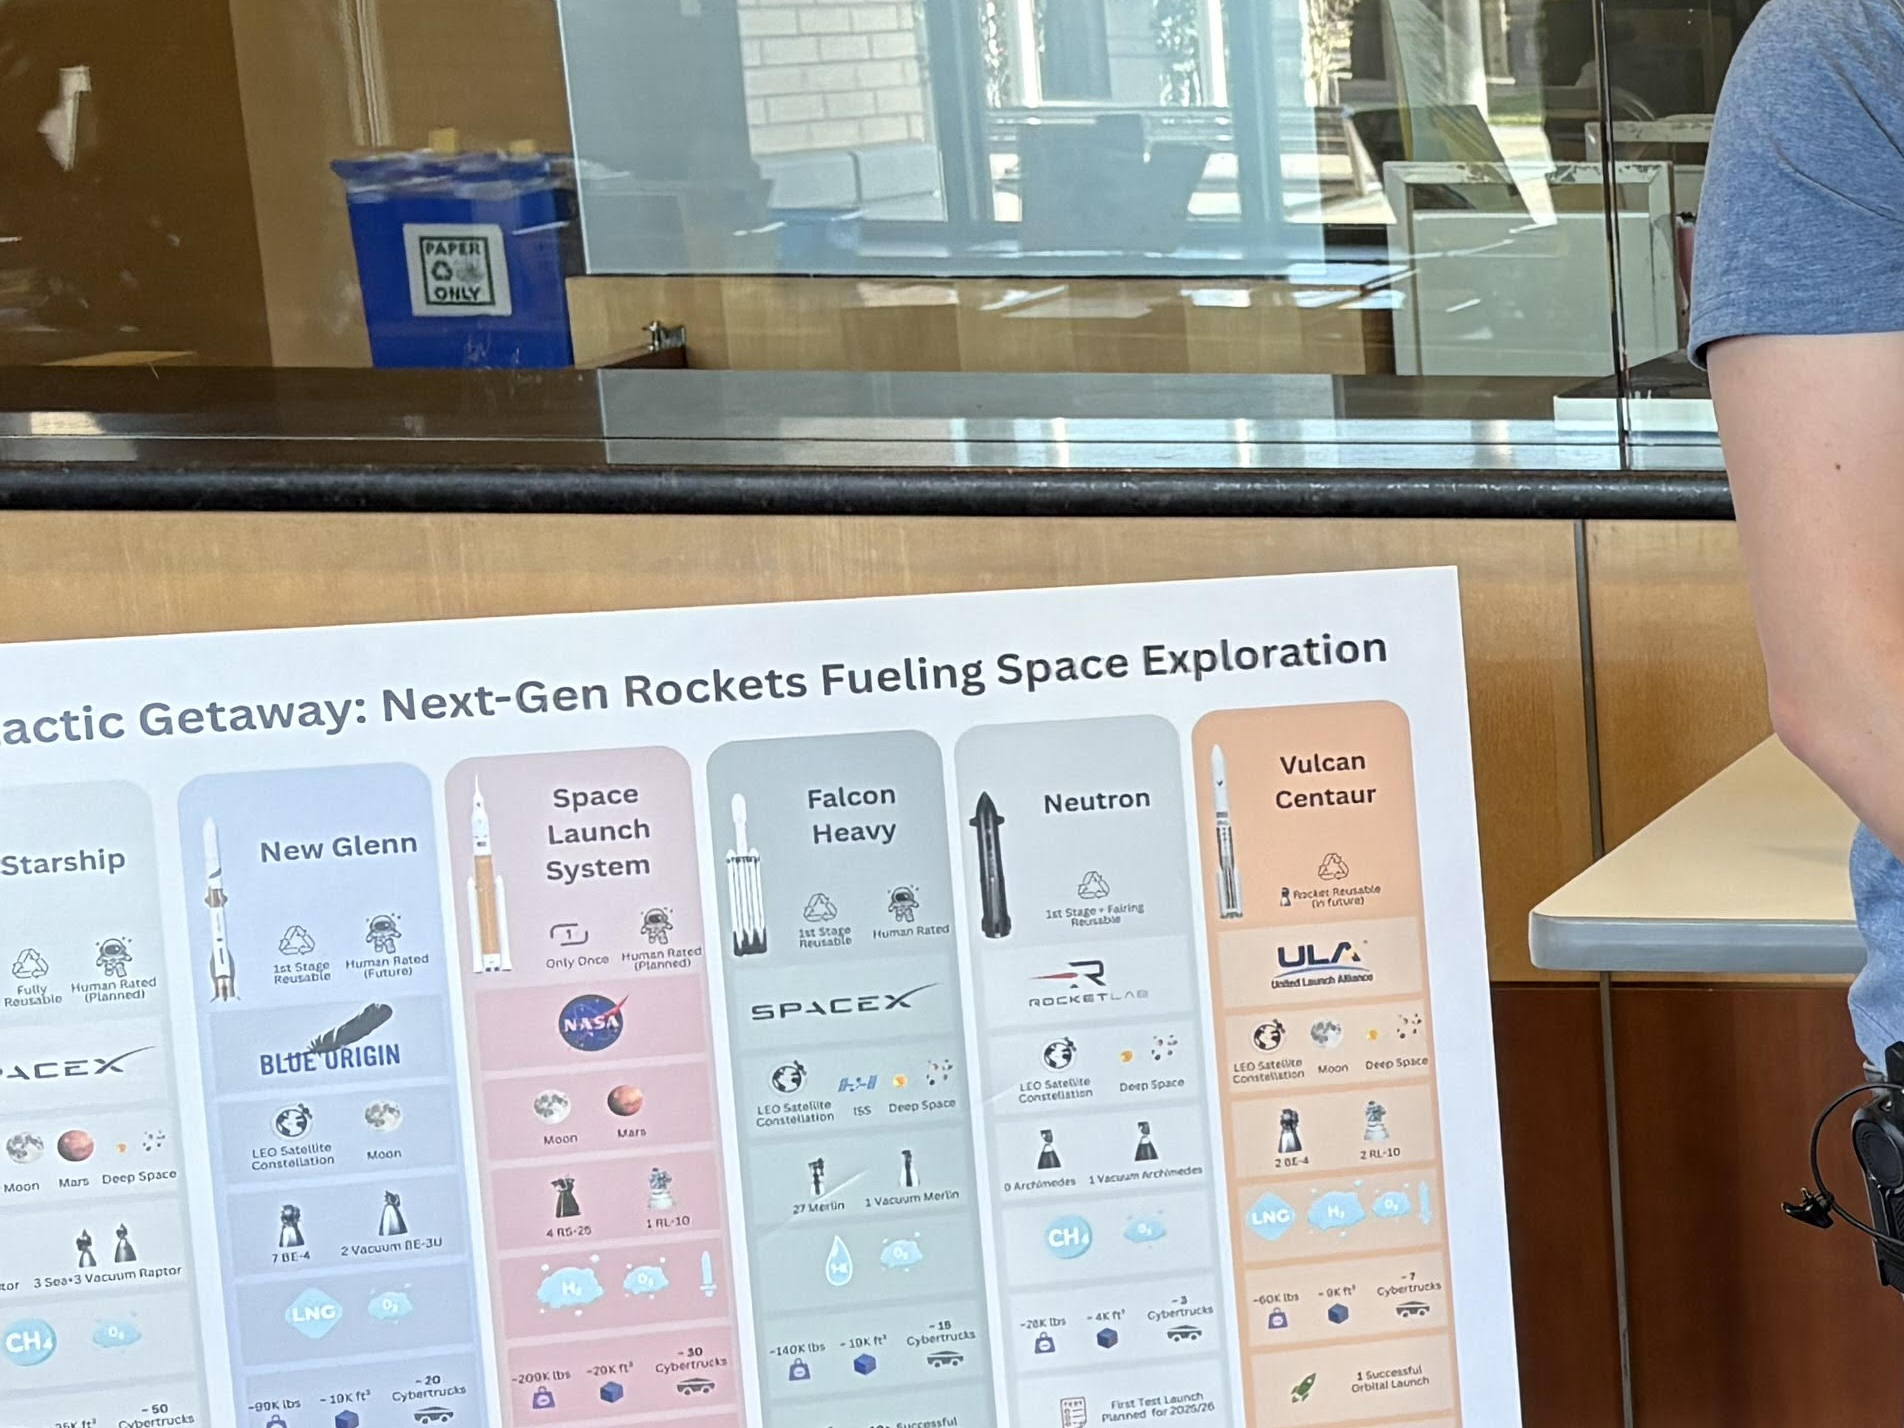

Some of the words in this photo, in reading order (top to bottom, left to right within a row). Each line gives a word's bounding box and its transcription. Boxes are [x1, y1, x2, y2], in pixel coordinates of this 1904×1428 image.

[425, 241, 481, 256] PAPER
[434, 286, 481, 301] ONLY
[0, 705, 125, 746] actic
[138, 690, 367, 737] Getaway:
[382, 679, 609, 723] Next-Gen
[625, 665, 808, 710] Rockets
[823, 655, 987, 696] Fueling
[997, 647, 1129, 693] Space
[1142, 632, 1389, 682] Exploration
[1280, 752, 1367, 776] Vulcan
[552, 785, 640, 816] Space
[807, 785, 897, 810] Falcon
[1044, 789, 1152, 815] Neutron
[1275, 785, 1378, 810] Centaur
[548, 818, 651, 846] Launch
[812, 822, 898, 846] Heavy
[260, 840, 324, 863] New
[332, 834, 419, 858] Glenn
[0, 847, 126, 876] Starship
[545, 855, 651, 886] System
[1277, 940, 1361, 969] ULA
[16, 983, 48, 998] Fully
[71, 979, 117, 995] Human
[84, 988, 146, 1005] (Planned)
[750, 981, 944, 1021] SPACEX
[563, 1012, 620, 1033] NASA
[0, 1045, 157, 1081] ACEX
[260, 1050, 317, 1076] BLUE
[324, 1042, 402, 1071] ORIGIN
[3, 1180, 41, 1194] Moon
[59, 1176, 90, 1189] Mars
[138, 1169, 178, 1184] Space
[1252, 1210, 1291, 1227] LNG
[291, 1304, 337, 1324] LNG
